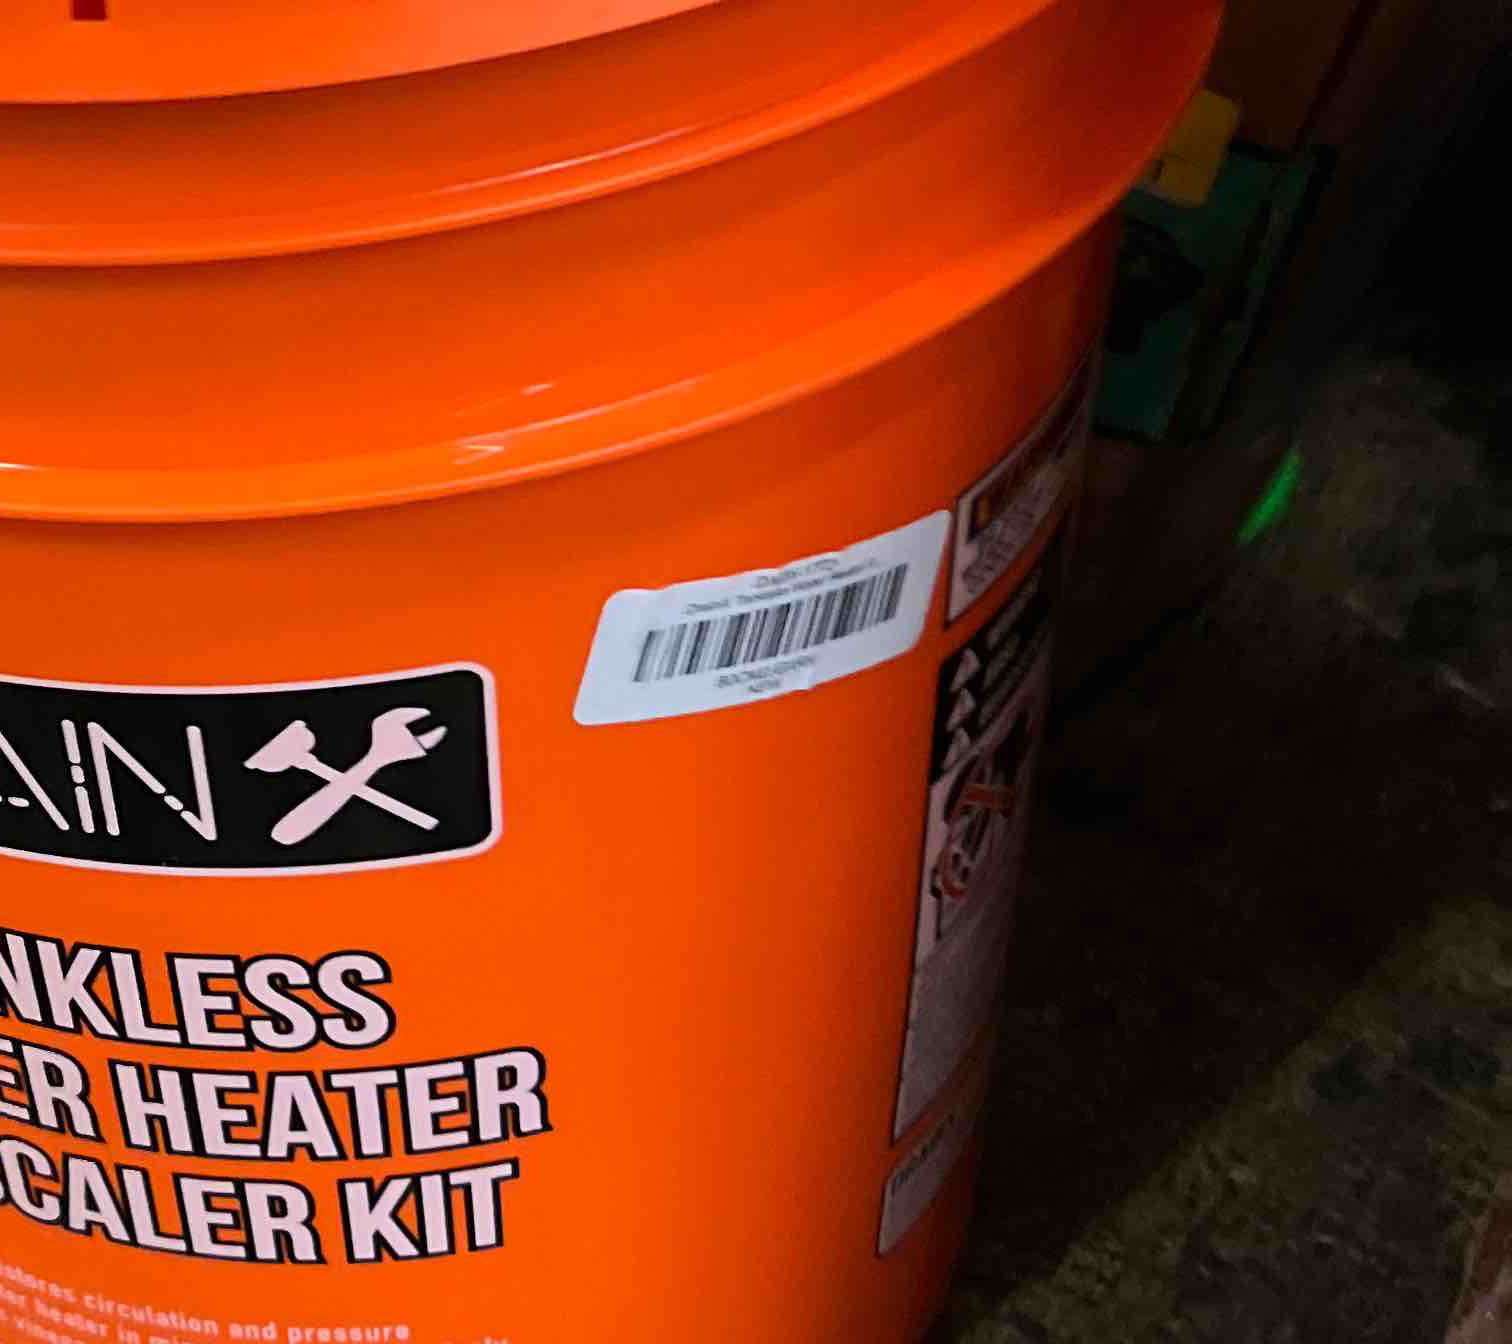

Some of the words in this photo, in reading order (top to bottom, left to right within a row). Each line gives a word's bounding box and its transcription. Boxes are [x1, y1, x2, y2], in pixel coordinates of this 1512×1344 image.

[109, 1045, 552, 1162] HEATER
[338, 1160, 521, 1265] KIT
[83, 1294, 220, 1338] circulation
[229, 1321, 278, 1343] and
